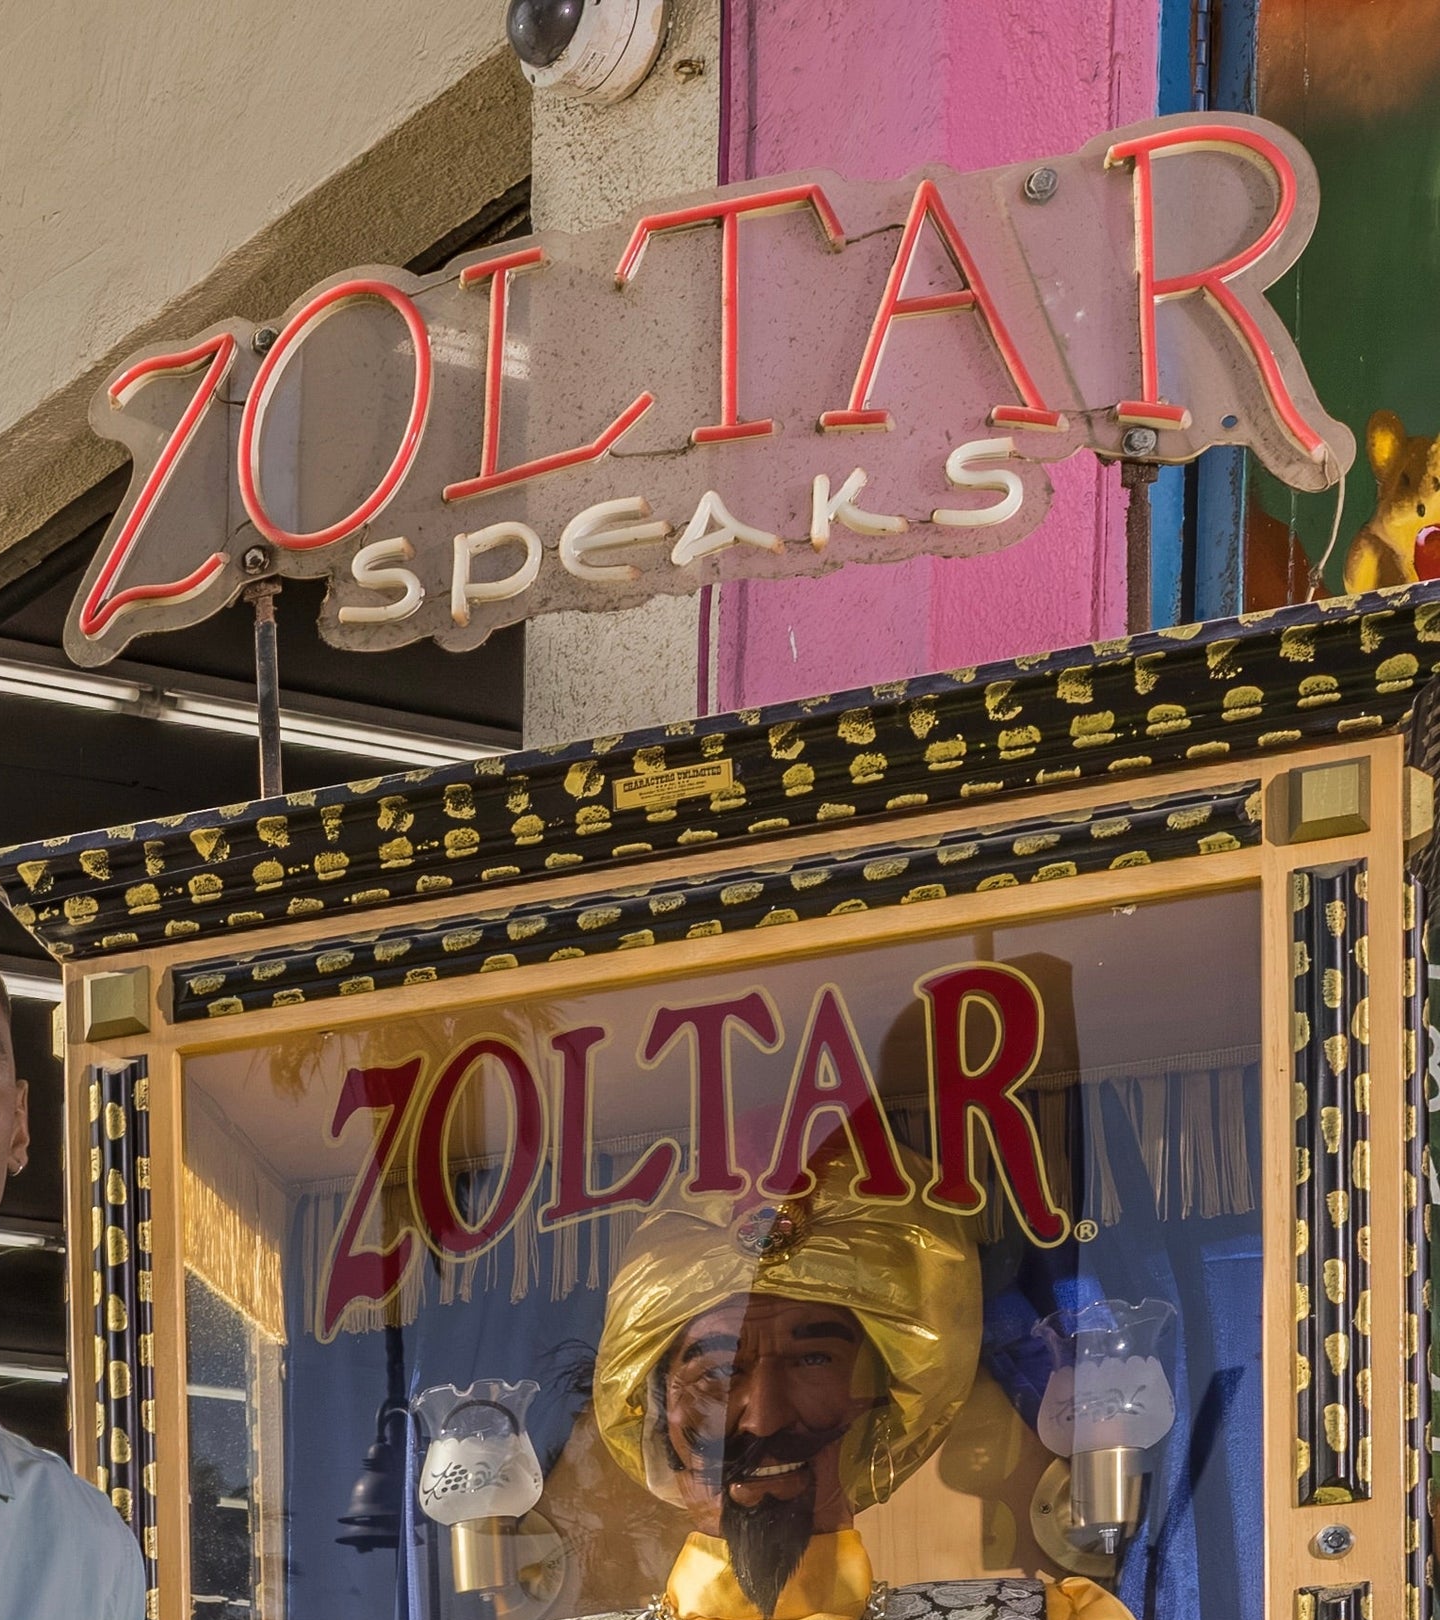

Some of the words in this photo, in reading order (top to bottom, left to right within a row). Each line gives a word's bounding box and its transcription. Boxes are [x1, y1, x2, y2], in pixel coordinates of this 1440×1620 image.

[81, 124, 1330, 637] ZOLTAR
[339, 436, 1024, 628] SPEAKS
[623, 772, 675, 793] CHARACTERS
[314, 959, 1072, 1344] ZOLTAR
